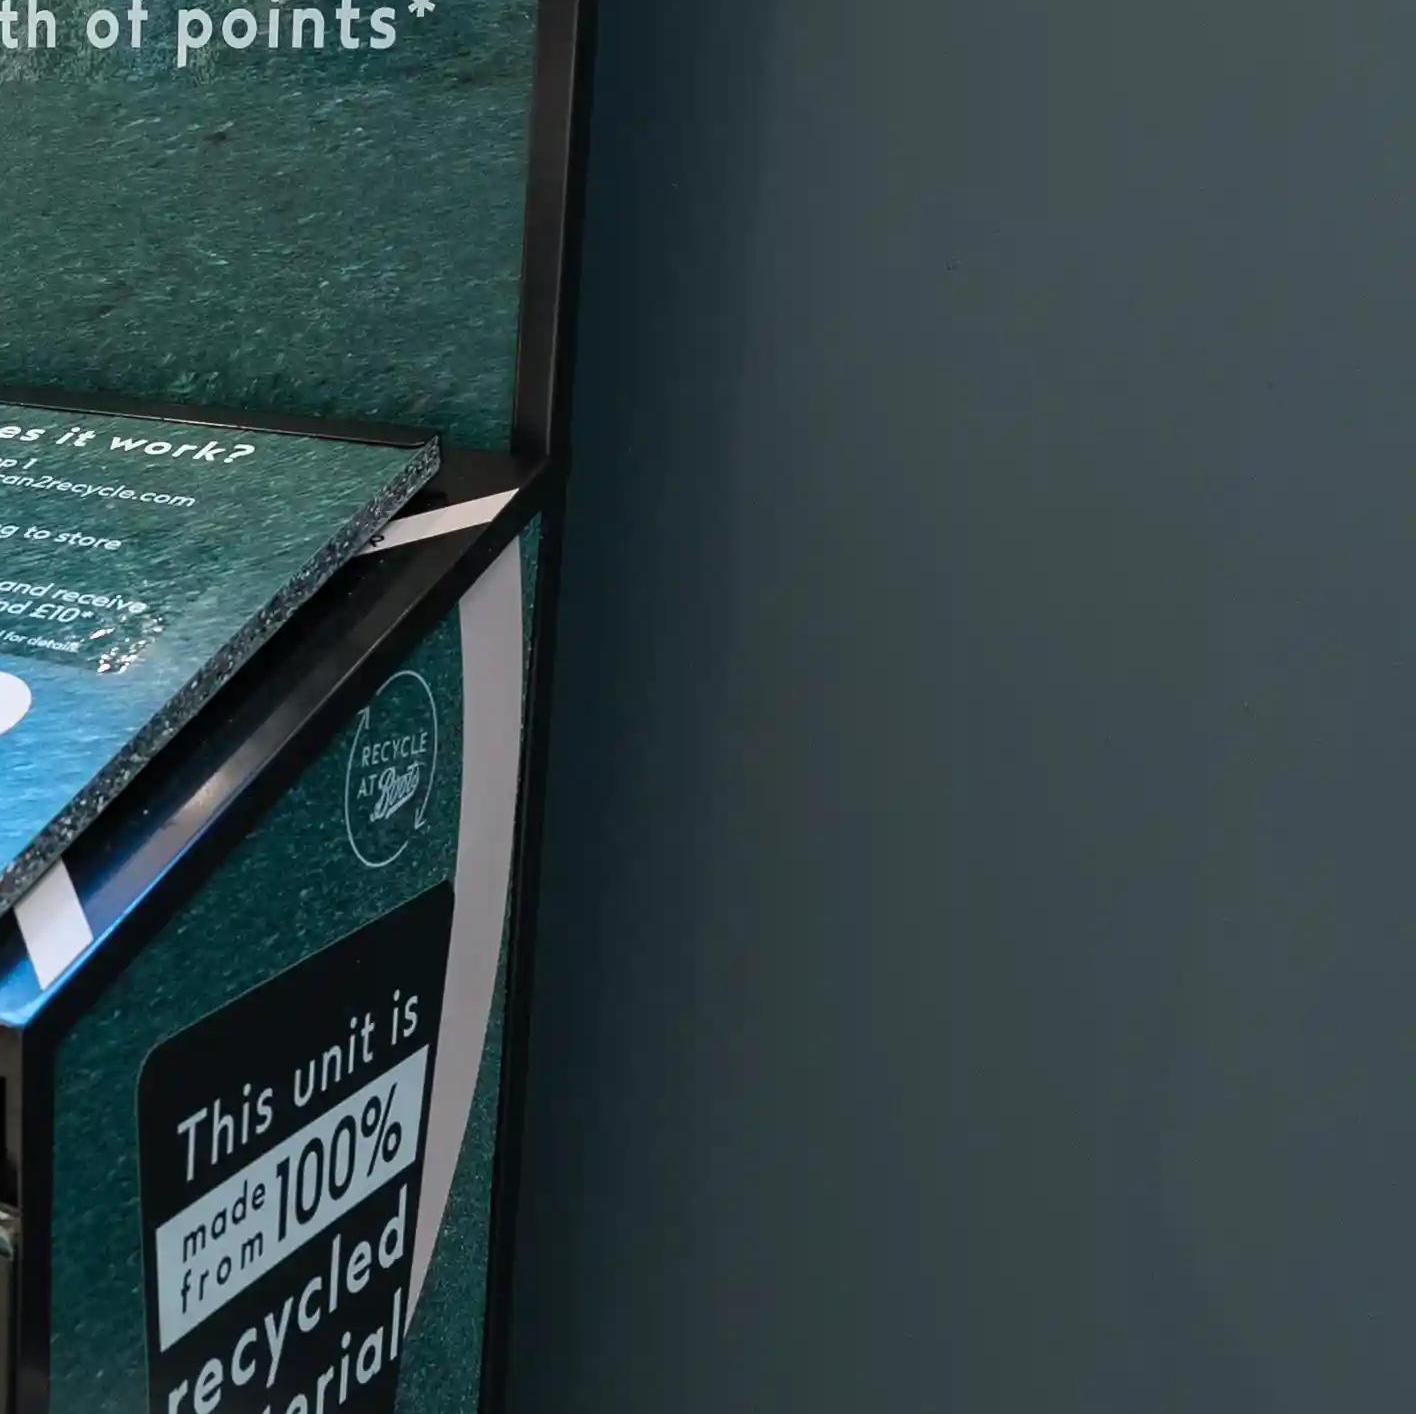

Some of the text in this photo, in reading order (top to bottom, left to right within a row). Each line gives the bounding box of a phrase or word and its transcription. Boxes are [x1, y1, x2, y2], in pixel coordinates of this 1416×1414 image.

[22, 457, 39, 469] 1
[56, 426, 98, 448] it
[109, 433, 257, 465] work?
[23, 525, 51, 540] to
[54, 530, 122, 551] store
[52, 588, 148, 614] receive
[3, 630, 27, 643] for
[361, 731, 429, 768] RECYCLE
[357, 761, 427, 823] AT Boots
[176, 988, 419, 1182] This unit is
[180, 1082, 403, 1316] from 100%
[181, 1180, 267, 1264] made
